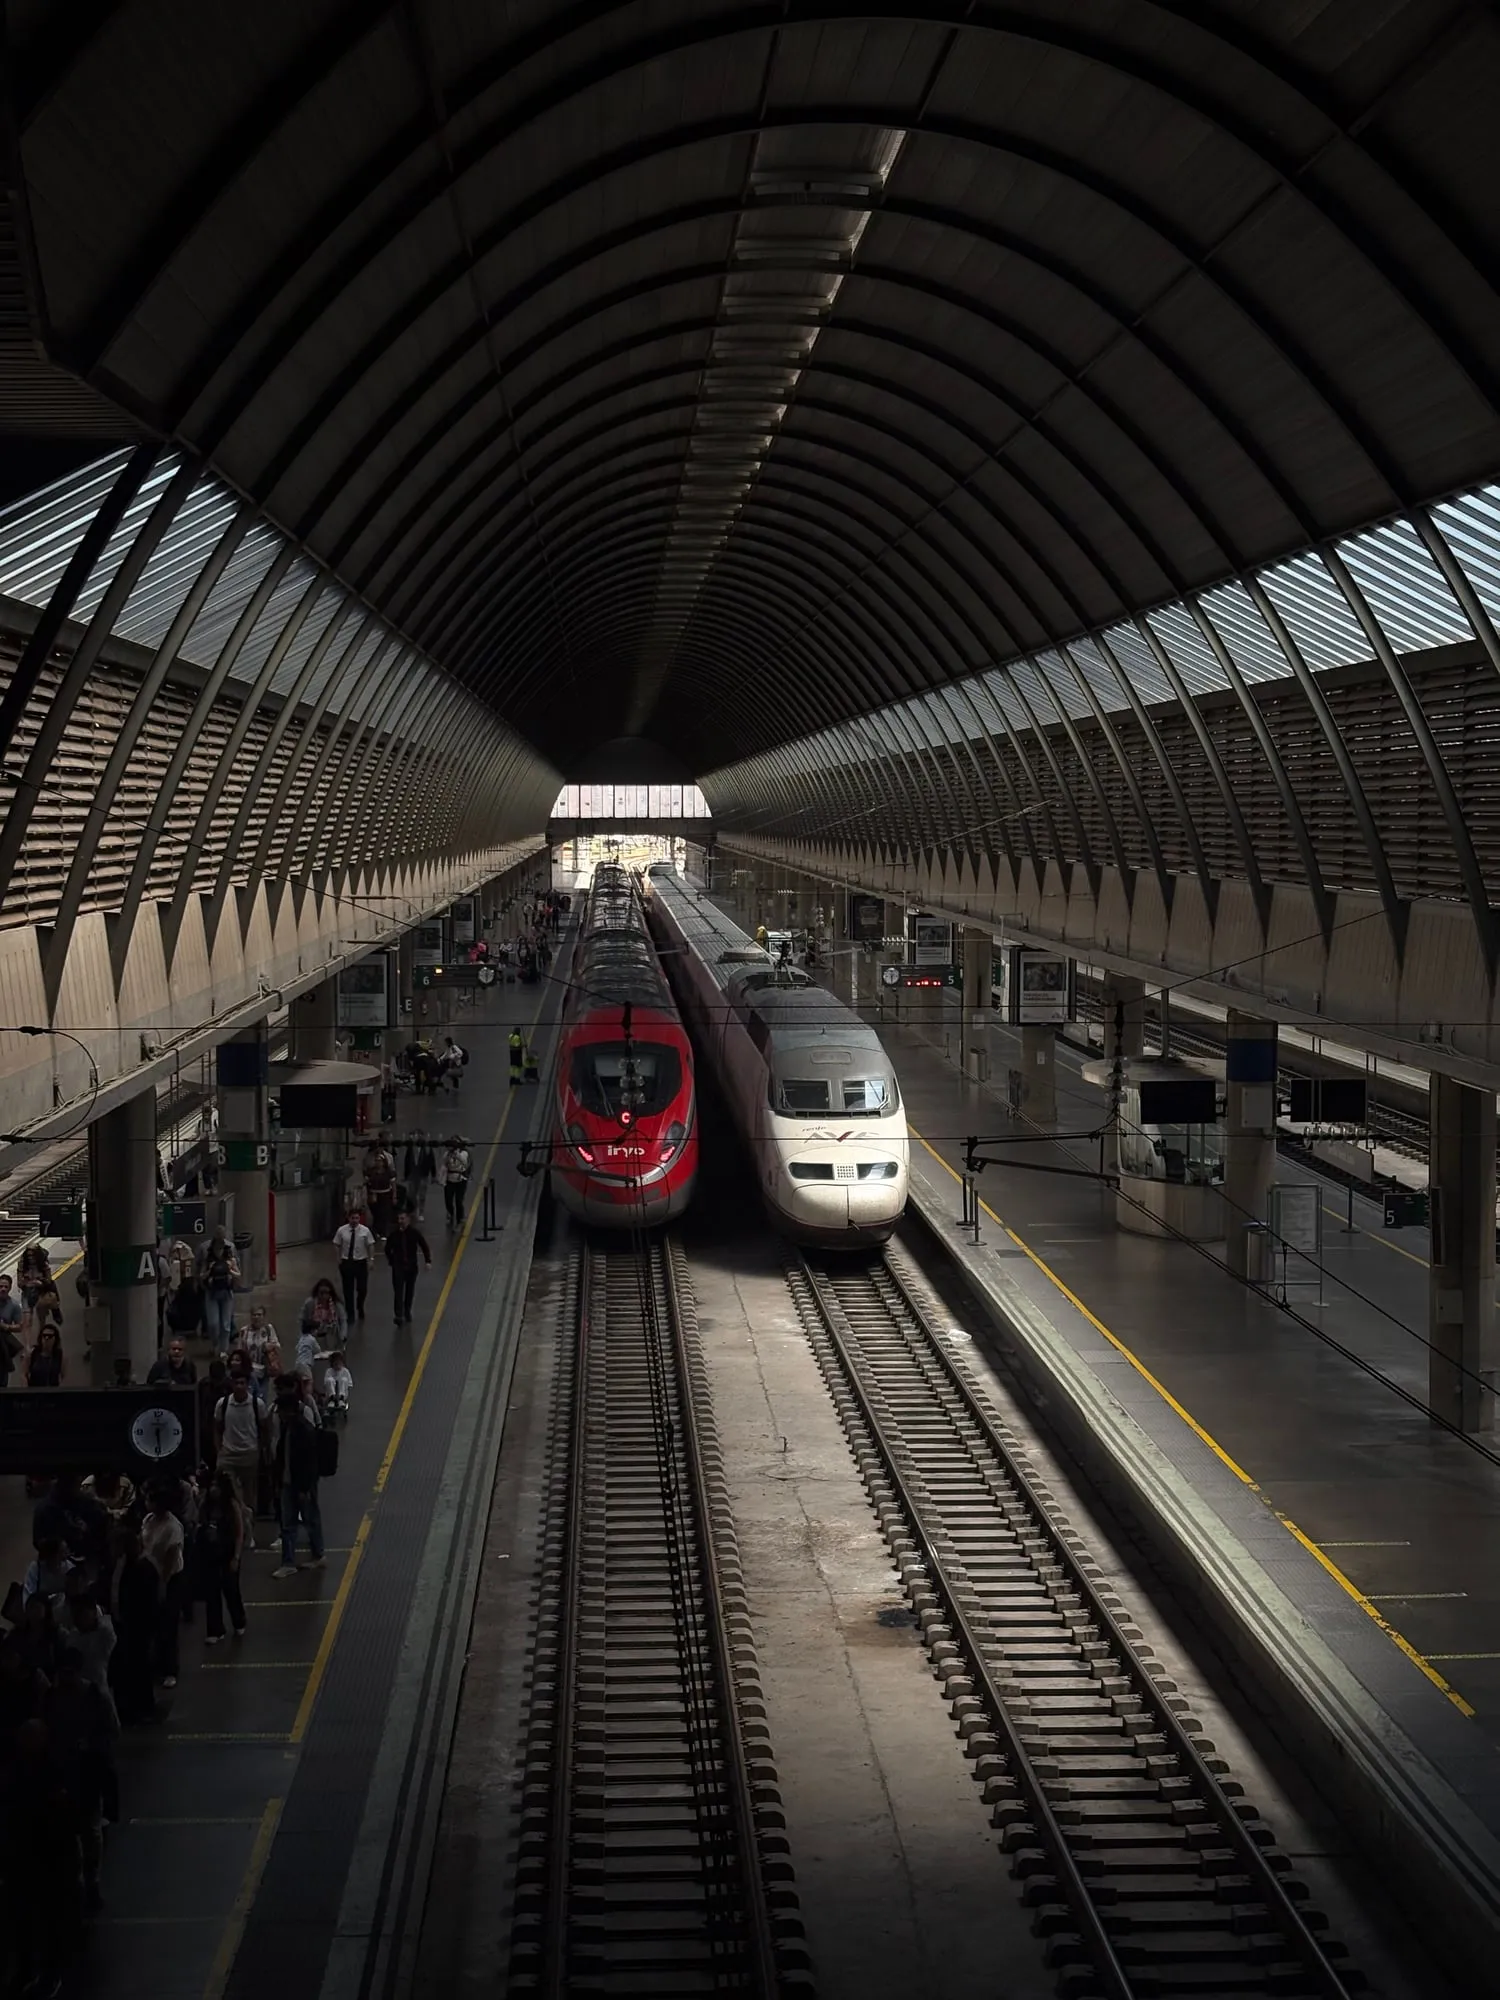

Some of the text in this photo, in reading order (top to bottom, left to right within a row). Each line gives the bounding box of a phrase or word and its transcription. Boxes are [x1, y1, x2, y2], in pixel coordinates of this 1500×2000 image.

[422, 976, 430, 986] 6
[947, 975, 956, 985] 5
[405, 999, 412, 1012] E
[256, 1145, 270, 1166] B
[607, 1144, 646, 1160] iryo
[1386, 1210, 1396, 1225] 5
[41, 1220, 52, 1237] 7
[193, 1217, 205, 1235] 6
[136, 1251, 156, 1280] A
